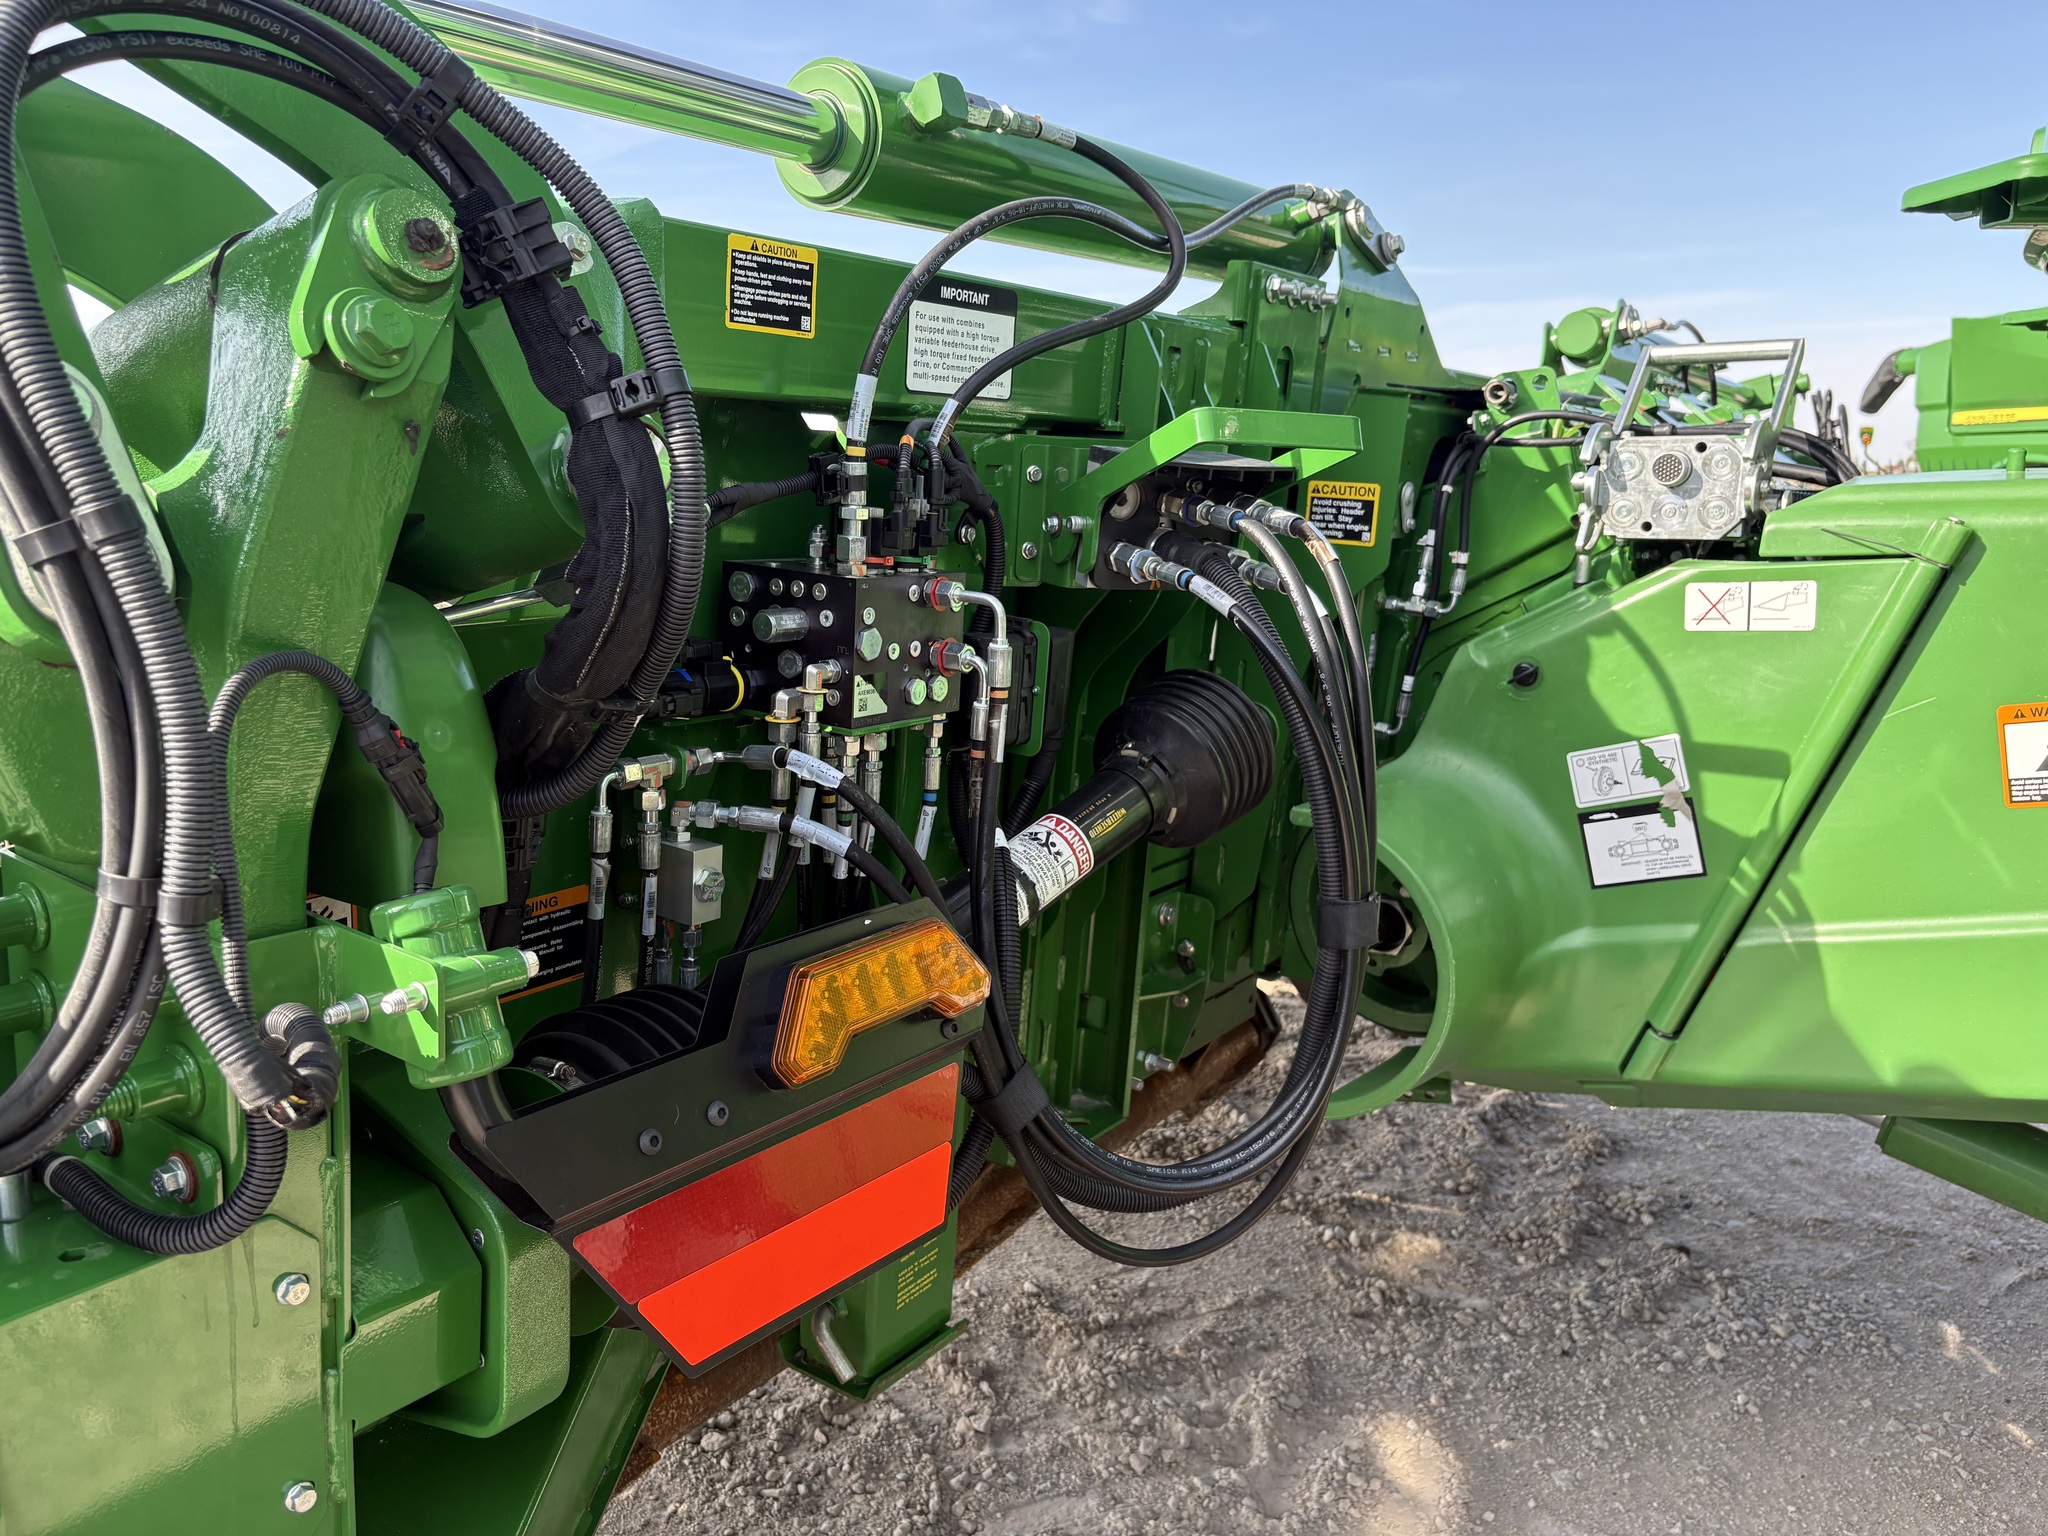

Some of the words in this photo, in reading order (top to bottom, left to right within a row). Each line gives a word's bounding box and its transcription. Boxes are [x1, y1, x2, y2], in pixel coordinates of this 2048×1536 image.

[168, 36, 231, 52] exceeds
[239, 45, 268, 62] SAE
[278, 56, 302, 73] 100
[963, 232, 971, 241] 21
[762, 243, 797, 258] CAUTION
[949, 240, 961, 251] MPa
[735, 260, 758, 268] operations.
[736, 252, 746, 260] Keep
[783, 260, 796, 269] during
[930, 252, 947, 270] (3000
[734, 276, 760, 284] power-driven
[776, 275, 792, 284] clothing
[792, 278, 802, 286] away
[915, 274, 929, 289] PSI)
[734, 285, 755, 294] Disengage
[756, 288, 780, 297] power-driven
[941, 286, 990, 306] IMPORTANT
[741, 293, 753, 302] engine
[768, 296, 788, 306] unclogging
[794, 300, 810, 309] servicing
[892, 291, 913, 325] exceeds
[758, 312, 772, 320] running
[916, 311, 926, 319] For
[929, 313, 939, 322] use
[942, 315, 954, 324] with
[956, 319, 985, 329] combines
[882, 328, 893, 345] SAE
[915, 324, 945, 335] equipped
[946, 328, 959, 337] with
[966, 331, 979, 341] high
[981, 334, 999, 343] torque
[915, 336, 940, 346] variable
[942, 339, 978, 351] feederhouse
[980, 344, 997, 354] drive,
[875, 349, 885, 364] 100
[914, 347, 928, 358] high
[930, 350, 950, 360] torque
[952, 352, 967, 361] fixed
[969, 354, 992, 364] feederh
[913, 360, 932, 369] drive,
[942, 362, 978, 373] CommandTo
[913, 371, 950, 382] multi-speed
[1321, 484, 1376, 497] CAUTION
[1333, 499, 1362, 509] crushing
[1312, 507, 1338, 515] injuries.
[1341, 508, 1365, 516] Header
[1325, 513, 1335, 521] tilt.
[1338, 515, 1353, 524] Stay
[1346, 524, 1369, 532] engine
[1325, 694, 1332, 706] 06
[1056, 822, 1091, 874] DANGER
[550, 909, 571, 918] hydraulic
[552, 919, 583, 931] disassembling
[539, 947, 555, 955] Manual
[555, 959, 582, 971] accumulator.
[120, 1044, 138, 1061] EN
[133, 1010, 153, 1037] 857
[146, 974, 166, 1000] 1SC
[1107, 1152, 1118, 1162] DN
[1235, 1130, 1276, 1160] IC-152/16
